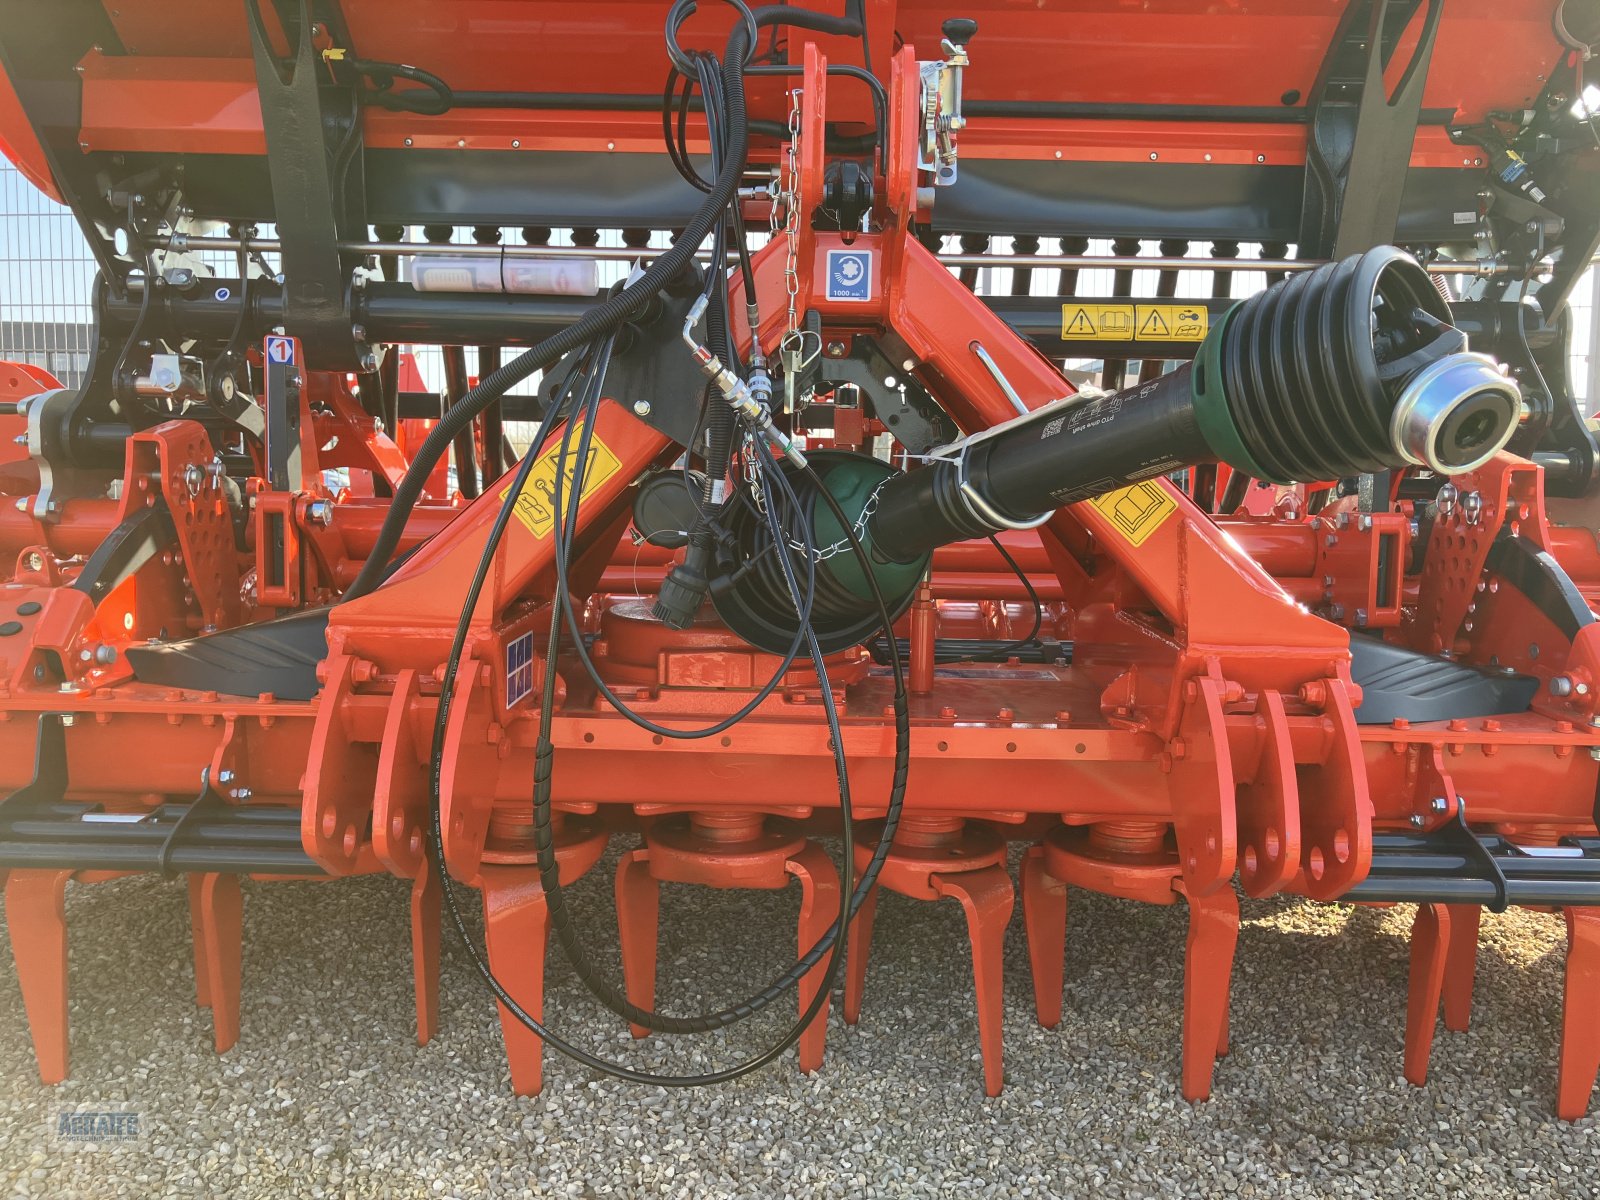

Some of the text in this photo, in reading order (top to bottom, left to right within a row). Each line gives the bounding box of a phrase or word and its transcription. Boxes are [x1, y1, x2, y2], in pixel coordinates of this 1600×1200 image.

[276, 341, 286, 360] 1
[1072, 415, 1114, 434] PTO drive shaft
